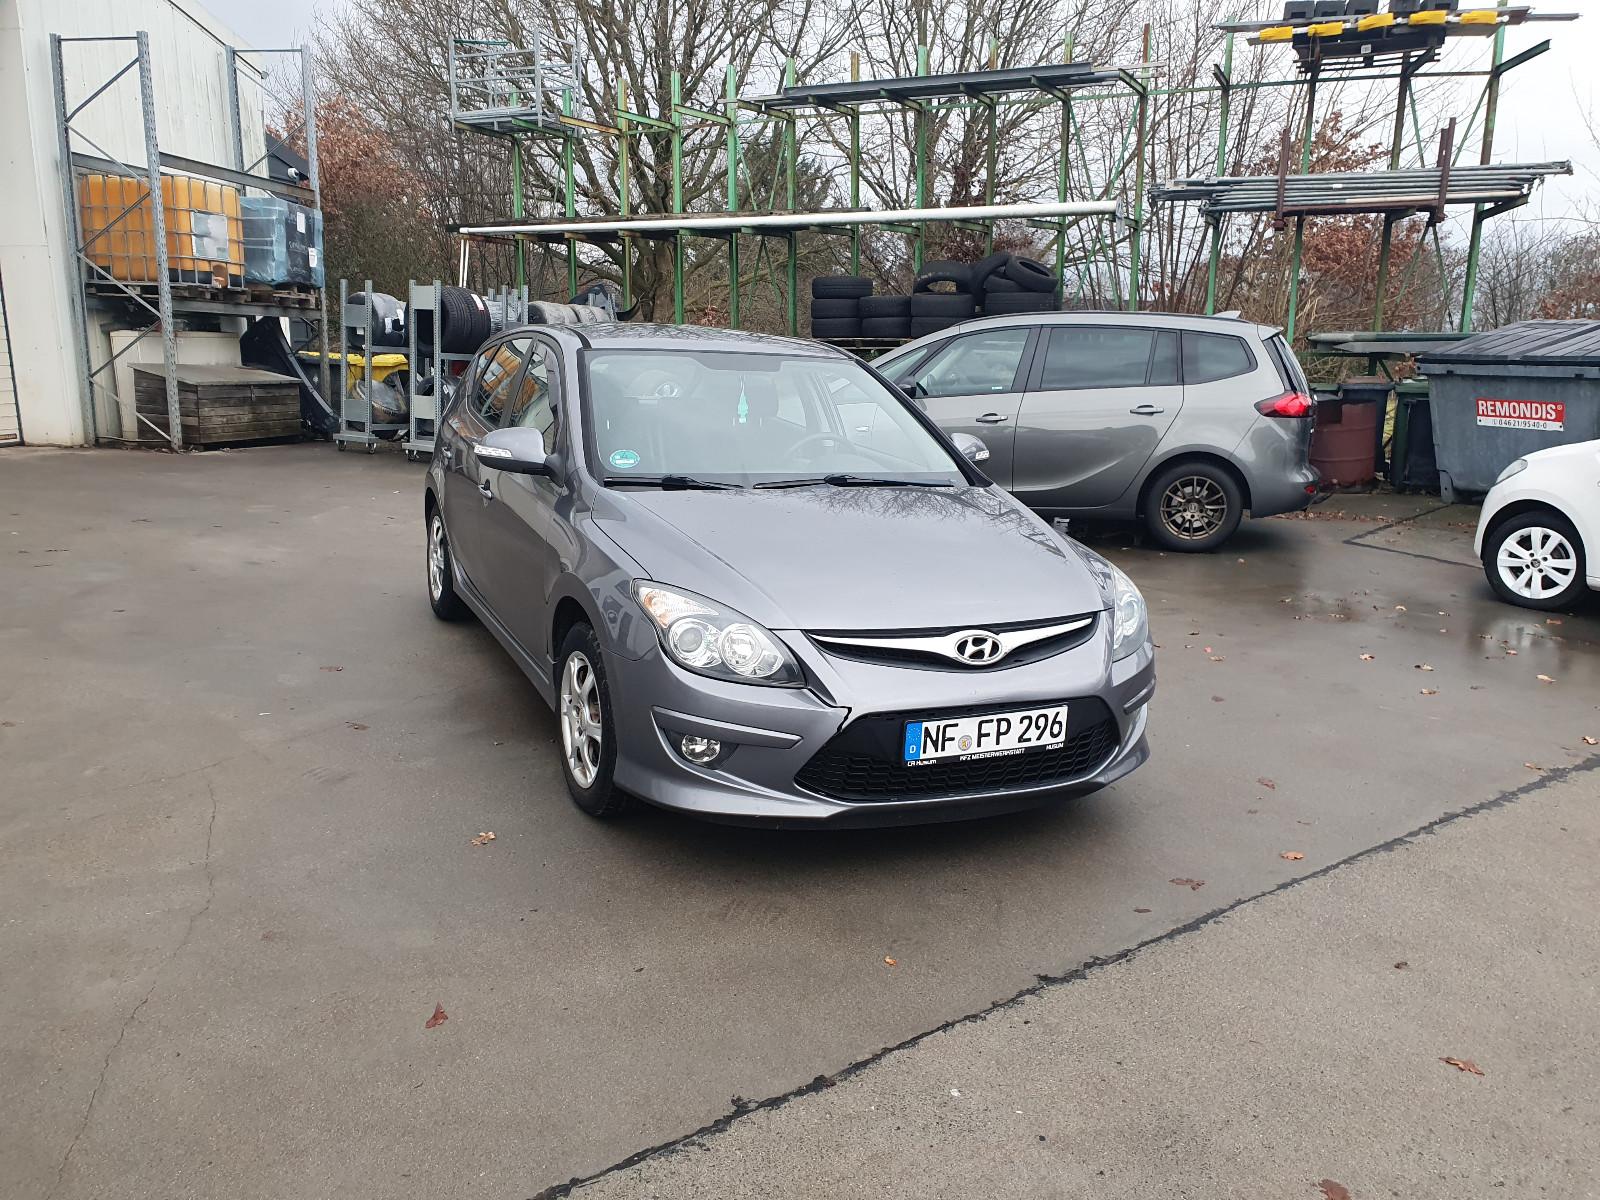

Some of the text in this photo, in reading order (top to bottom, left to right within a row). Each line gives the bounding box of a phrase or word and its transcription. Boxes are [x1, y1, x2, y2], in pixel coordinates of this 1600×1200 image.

[1478, 401, 1556, 419] REMONDIS
[909, 712, 1063, 754] D NF FP 296
